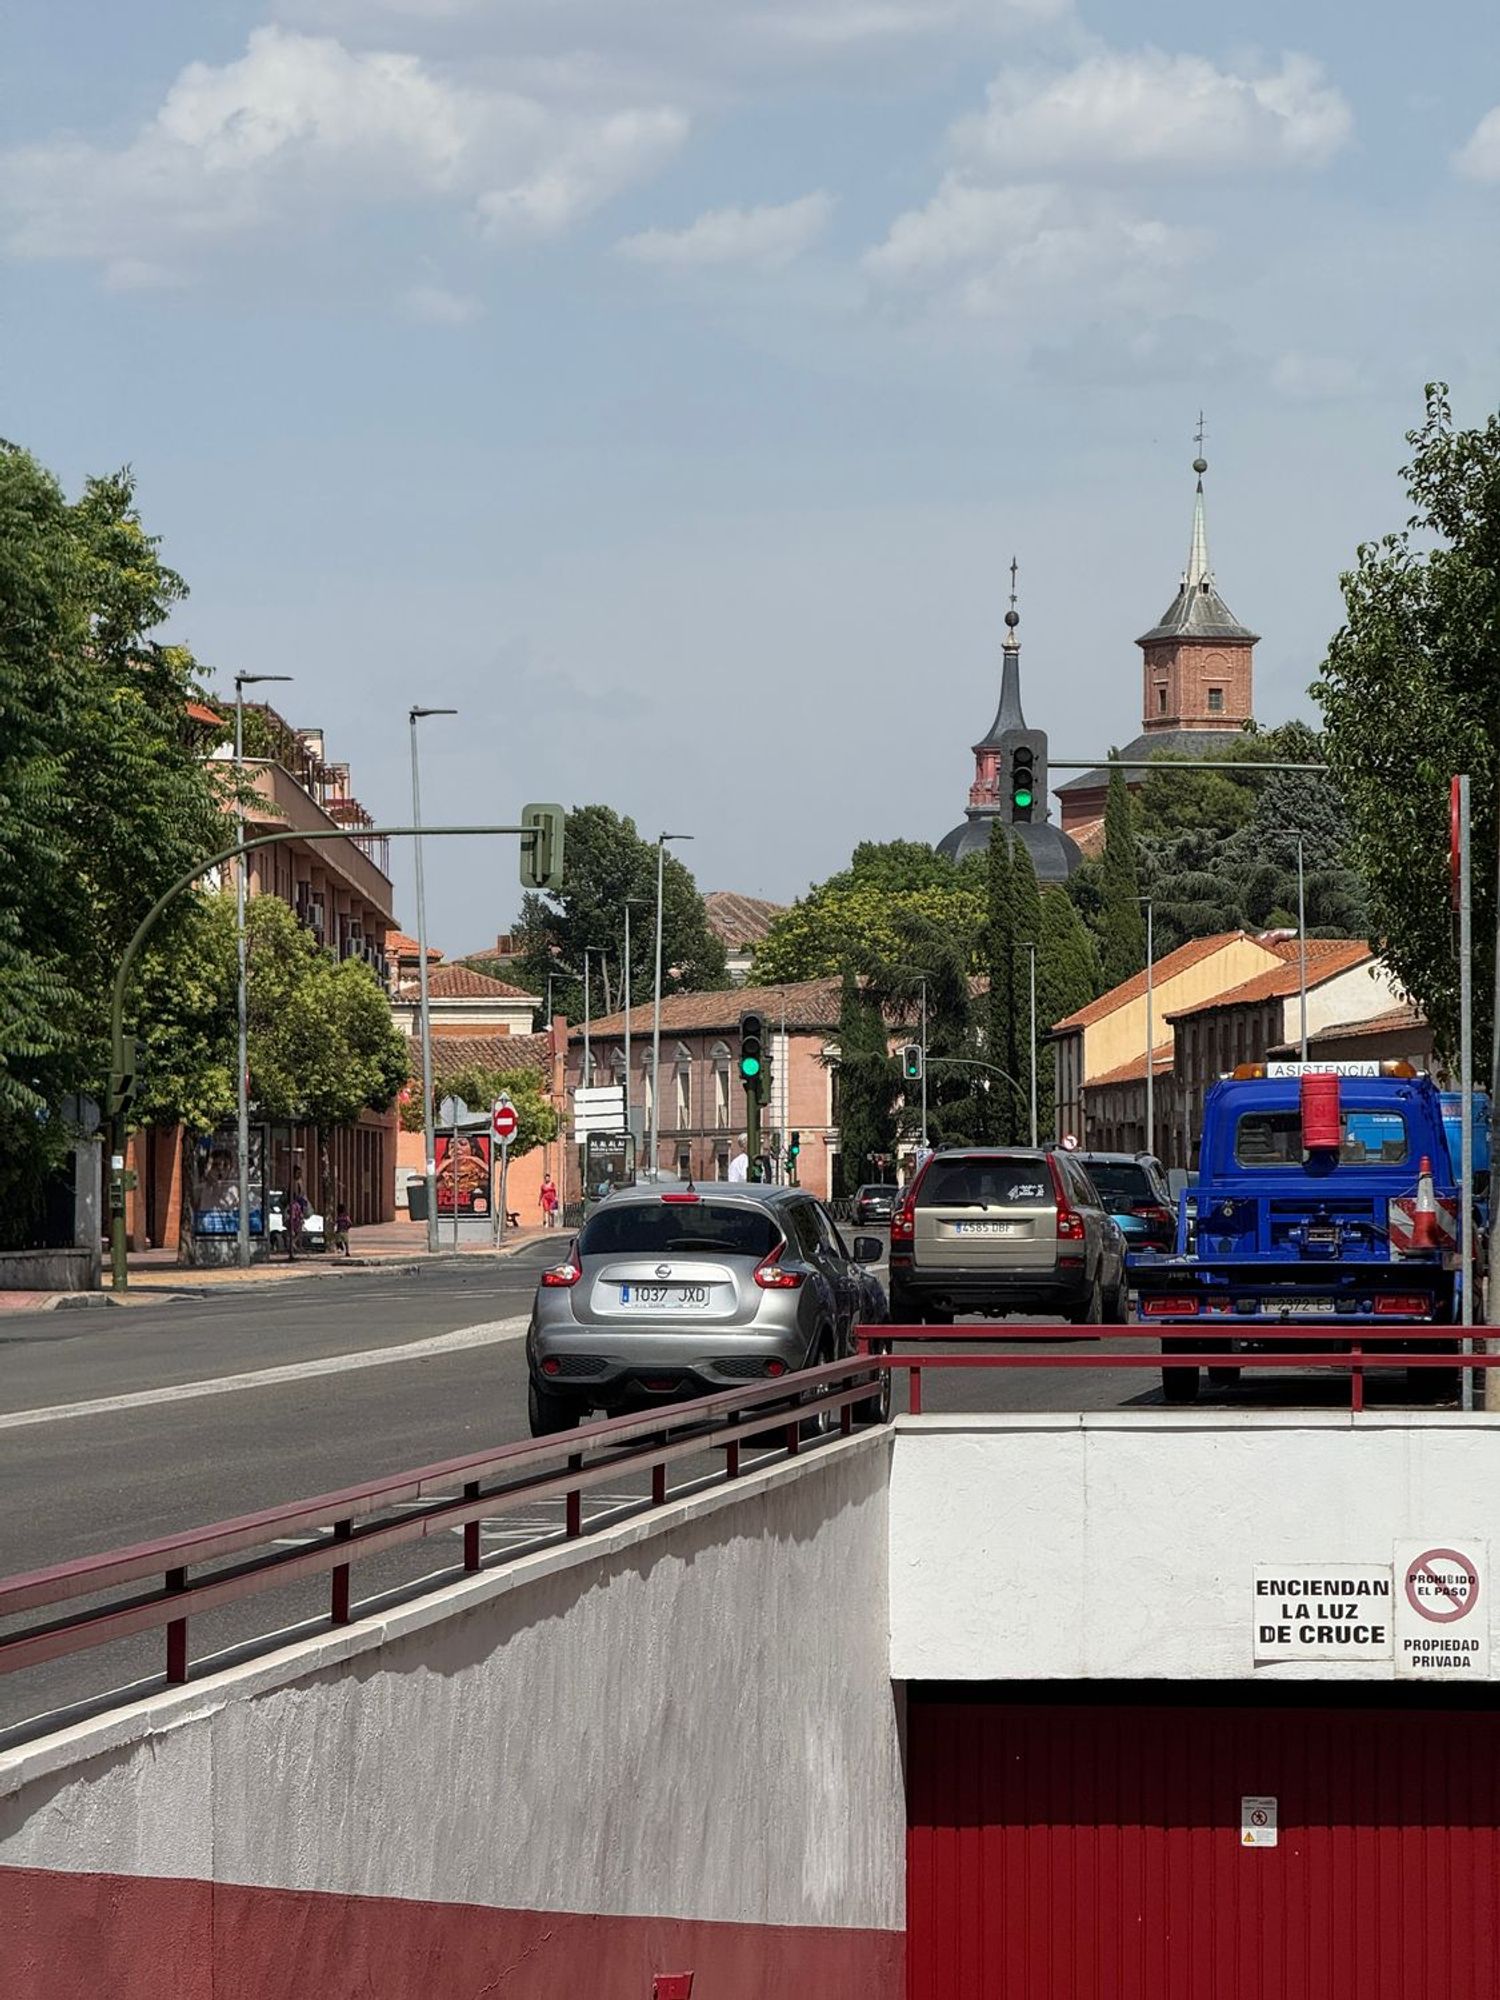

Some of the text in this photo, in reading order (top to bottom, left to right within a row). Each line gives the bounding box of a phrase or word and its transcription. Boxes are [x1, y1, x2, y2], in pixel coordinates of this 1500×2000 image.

[1274, 1064, 1376, 1077] ASISTENCIA
[962, 1221, 989, 1233] 4585
[635, 1286, 705, 1302] 1037 JXD
[1409, 1574, 1476, 1584] PROHIBIDO
[1256, 1580, 1389, 1596] ENCIENDAN
[1418, 1587, 1467, 1596] EL PASO
[1282, 1604, 1359, 1620] LA LUZ
[1259, 1625, 1385, 1643] DE CRUCE
[1403, 1639, 1480, 1651] PROPIEDAD
[1412, 1656, 1471, 1667] PRIVADA
